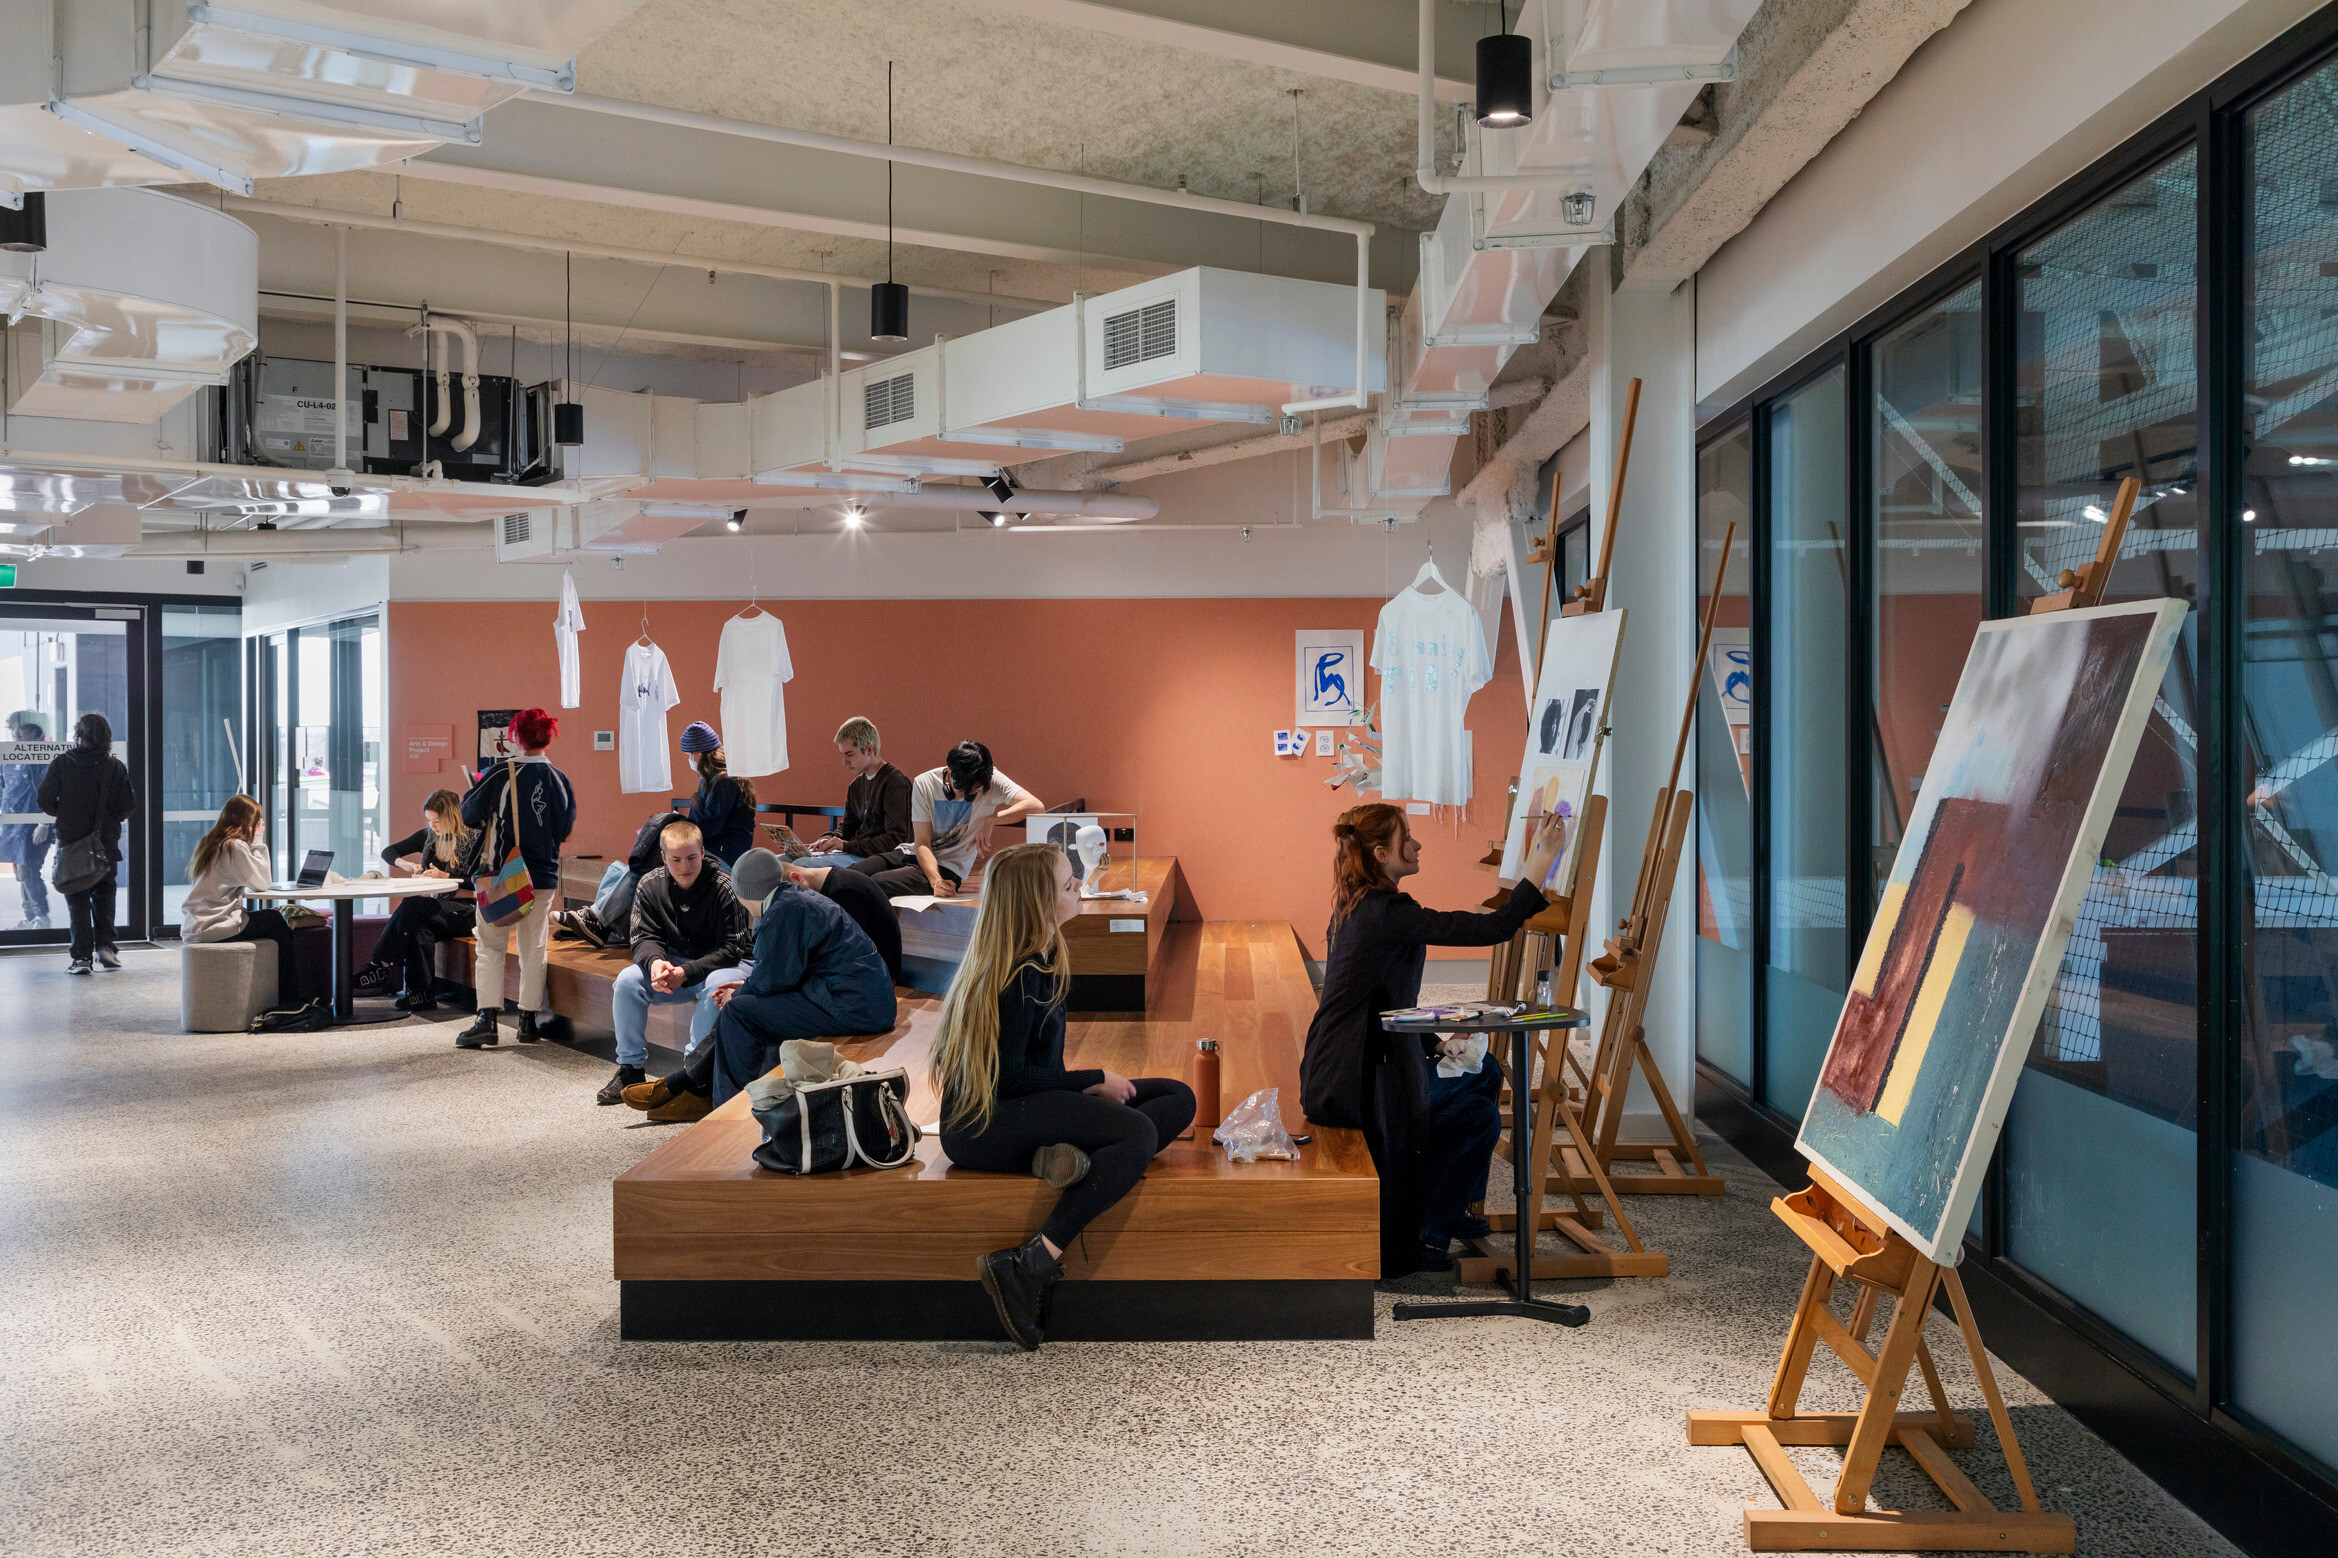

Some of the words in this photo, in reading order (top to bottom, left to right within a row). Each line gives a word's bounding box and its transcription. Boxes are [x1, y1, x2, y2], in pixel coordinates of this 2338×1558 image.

[297, 400, 336, 410] CU-L4-02
[14, 744, 77, 752] ALTERNATIV
[3, 753, 51, 761] LOCATED
